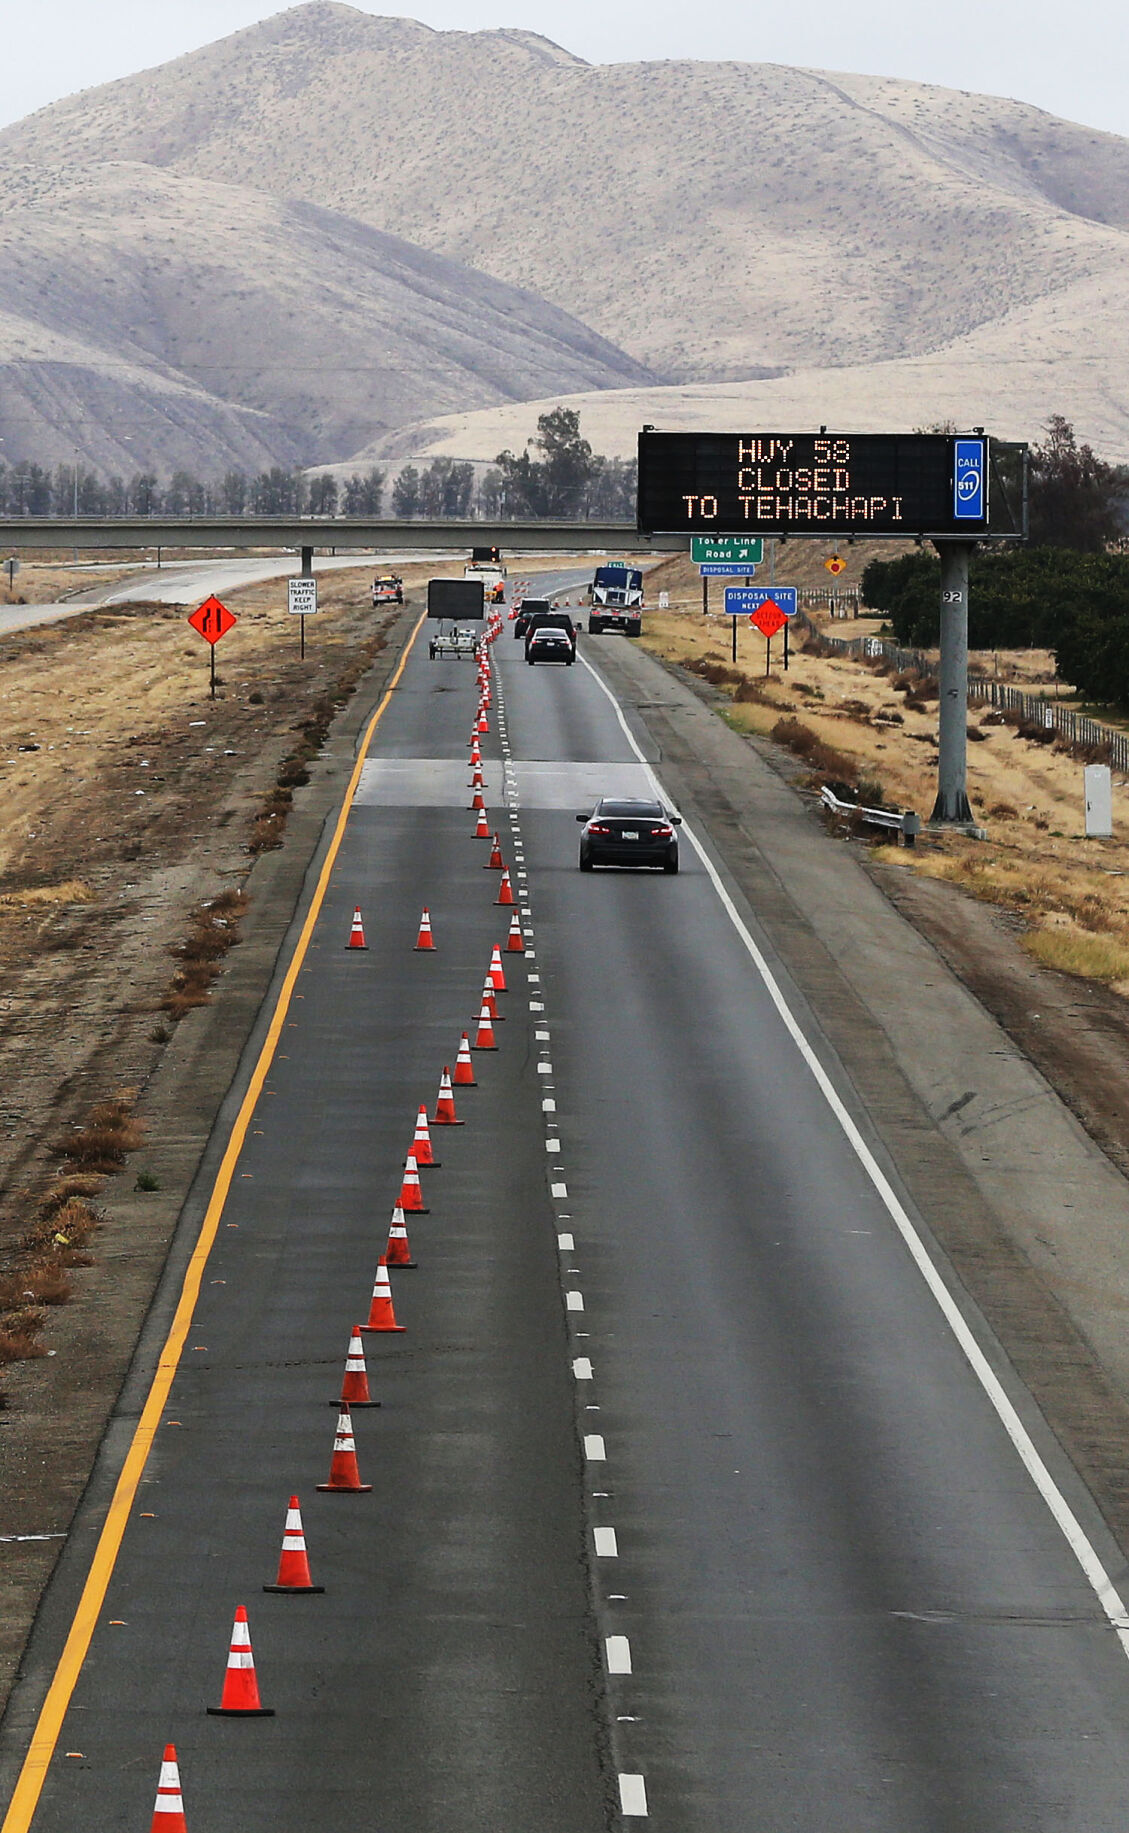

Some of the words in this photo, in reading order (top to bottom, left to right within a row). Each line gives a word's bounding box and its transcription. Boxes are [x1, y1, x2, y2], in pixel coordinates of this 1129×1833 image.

[738, 439, 794, 463] HWY
[814, 440, 850, 463] 58
[957, 458, 980, 468] CALL
[738, 467, 850, 491] CLOSED
[958, 481, 974, 490] 511
[682, 495, 718, 519] TO
[738, 496, 902, 519] TEHACHAPI
[733, 537, 756, 545] Line
[705, 549, 732, 558] Road
[728, 592, 769, 600] DISPOSAL
[774, 592, 793, 600] SITE
[943, 591, 961, 602] 92
